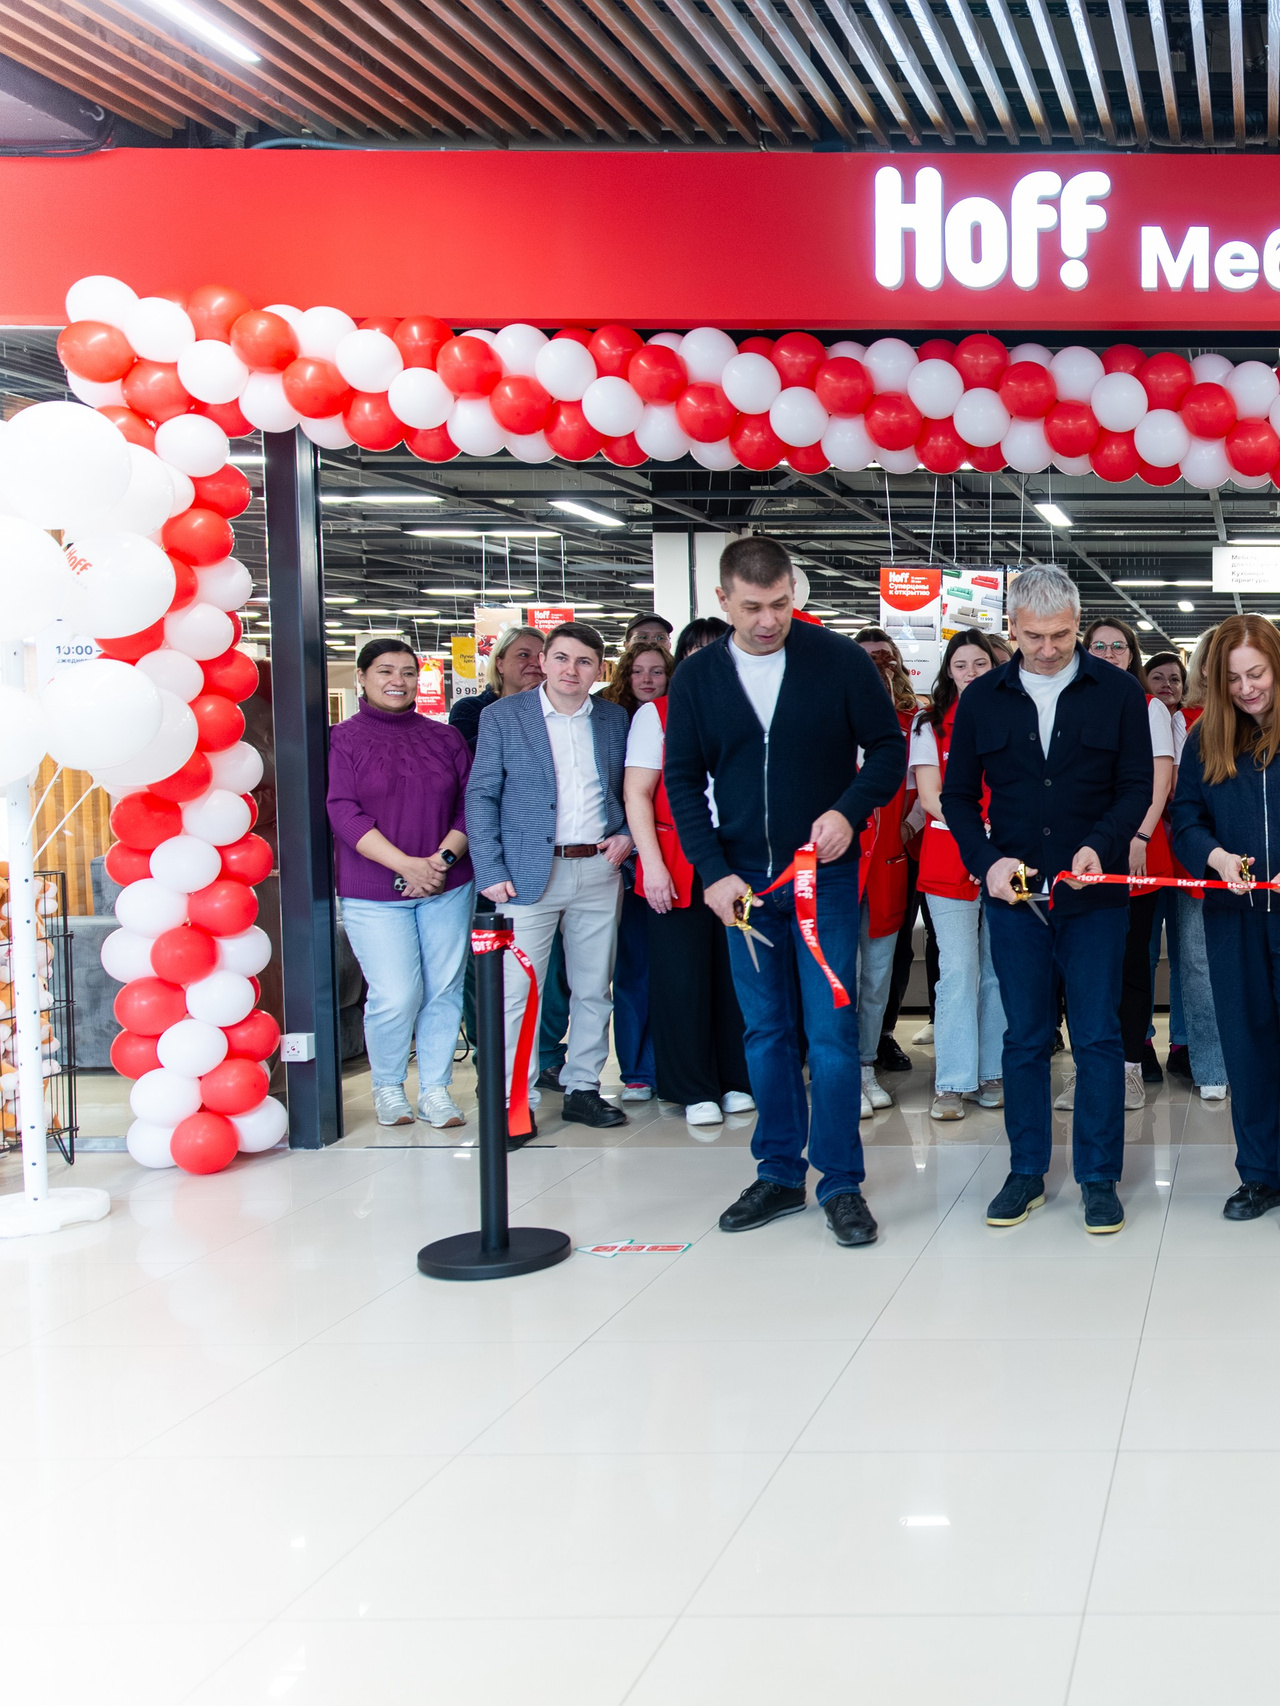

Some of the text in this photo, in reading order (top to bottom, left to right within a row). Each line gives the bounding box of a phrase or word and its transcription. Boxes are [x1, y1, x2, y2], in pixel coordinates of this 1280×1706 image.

[874, 165, 1112, 291] Hoff
[888, 583, 930, 592] Суперцены
[889, 571, 910, 583] Hoff
[796, 869, 814, 900] Hoff
[1126, 876, 1157, 885] Hoff
[1177, 879, 1207, 887] Hoff
[800, 918, 818, 949] Hoff
